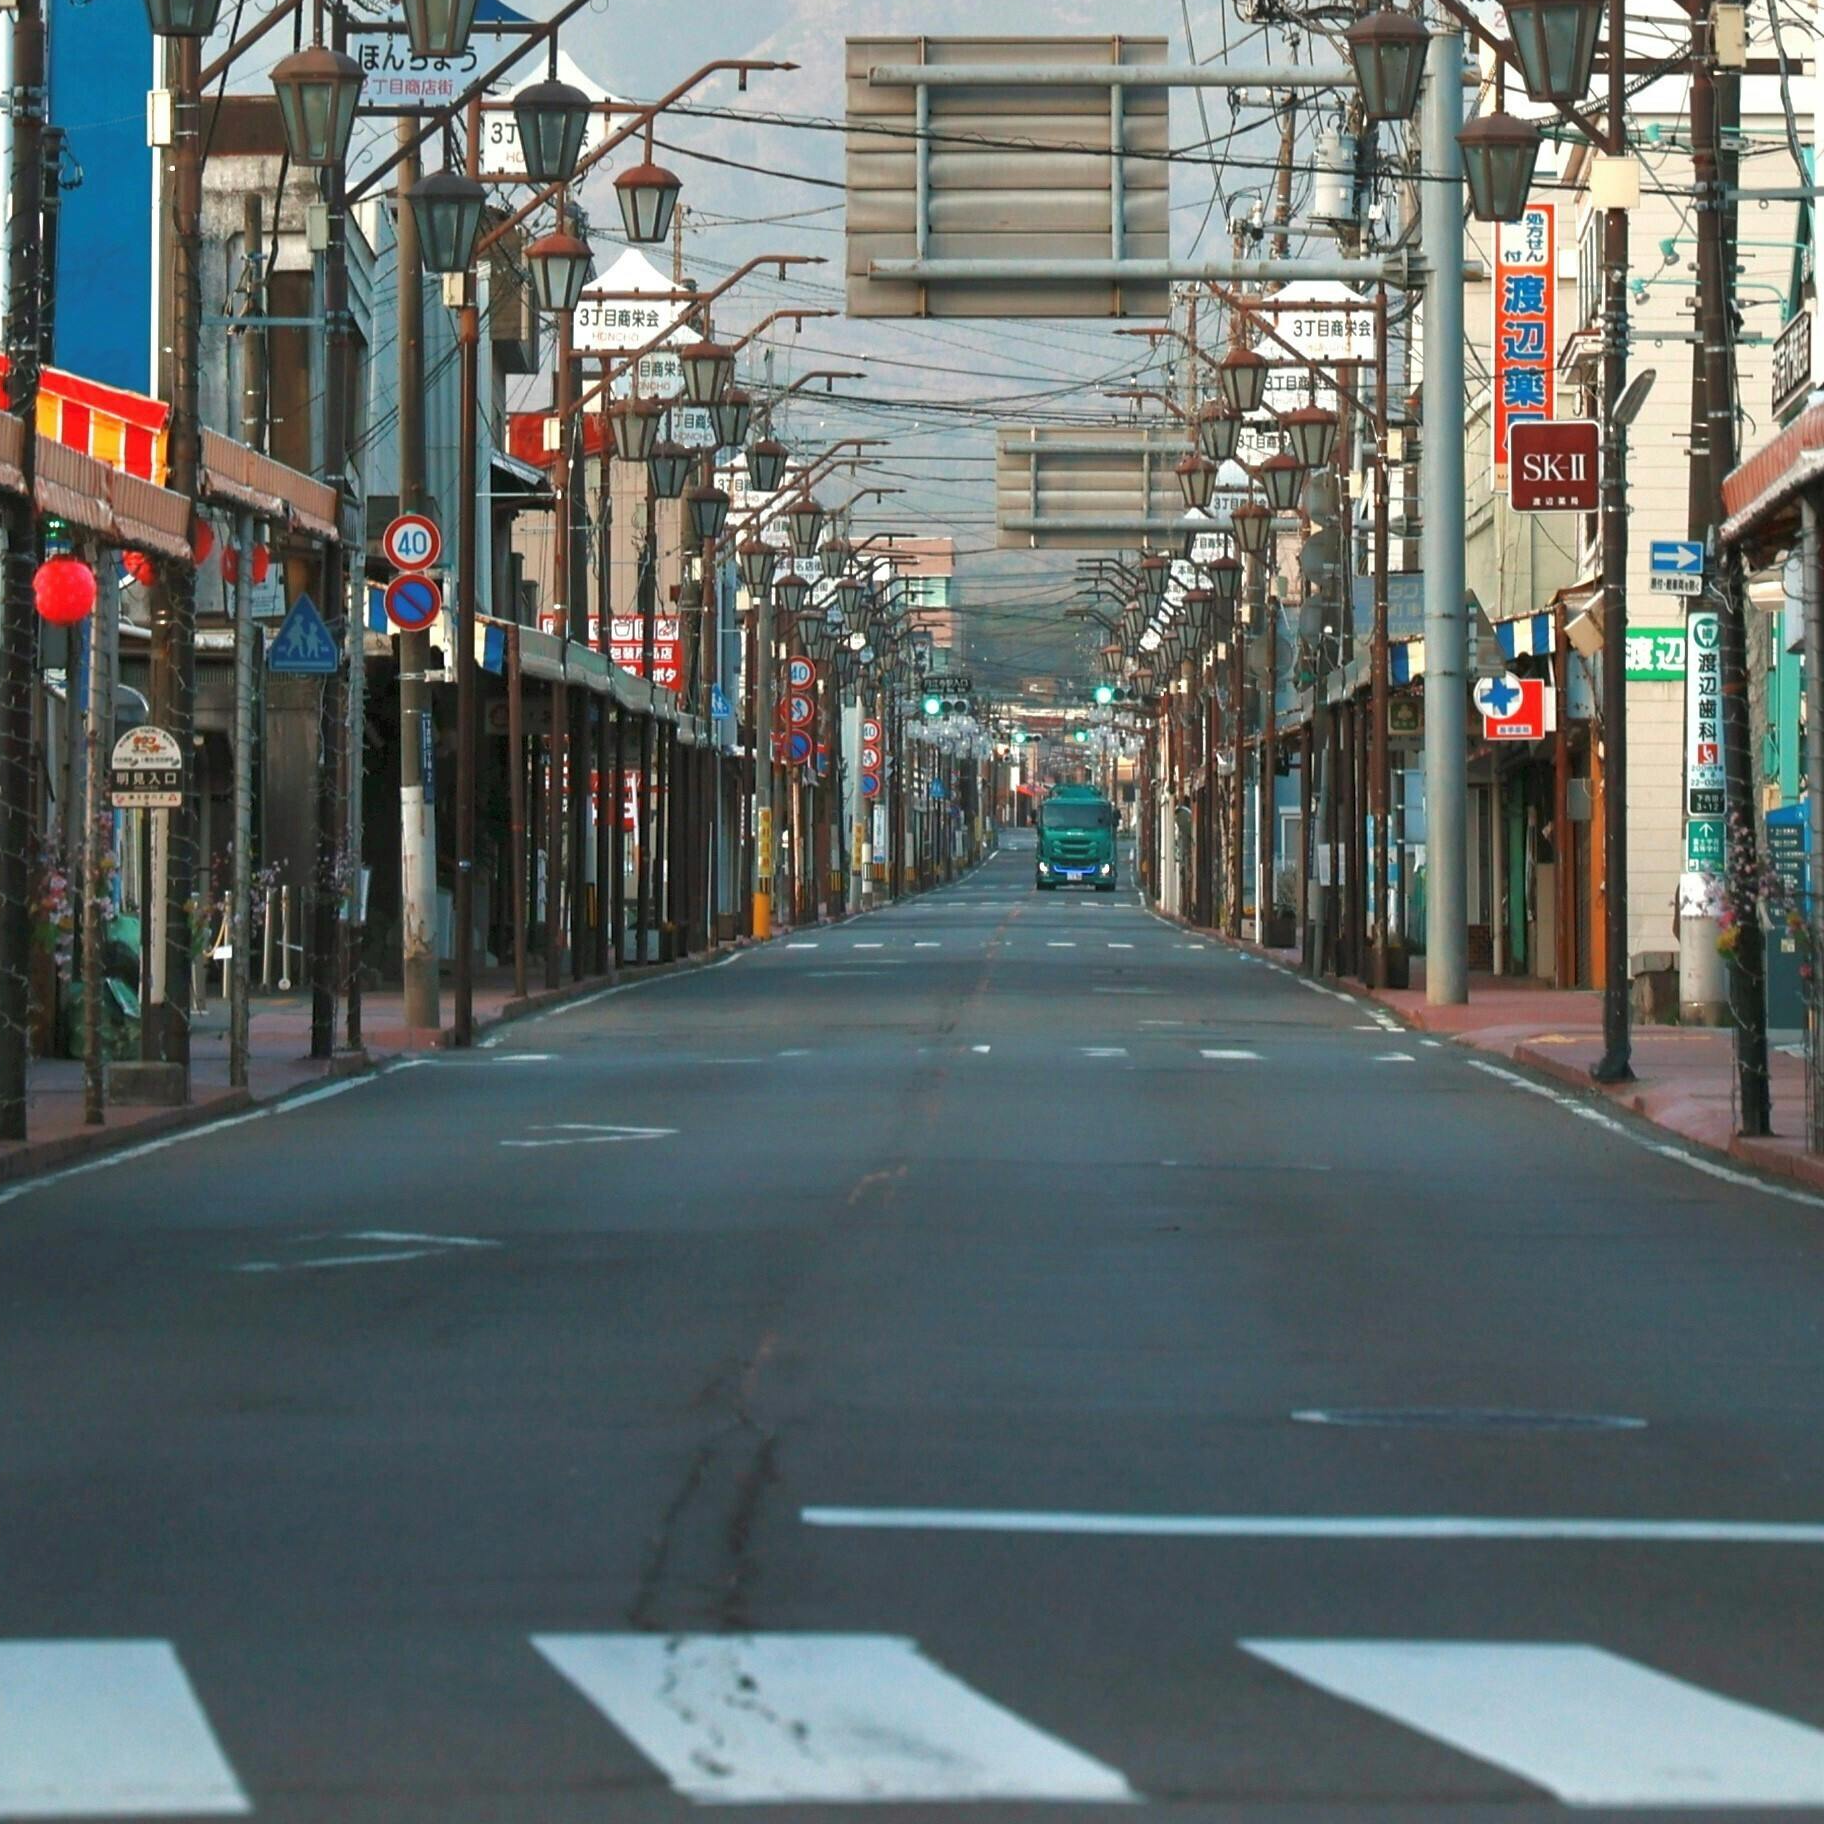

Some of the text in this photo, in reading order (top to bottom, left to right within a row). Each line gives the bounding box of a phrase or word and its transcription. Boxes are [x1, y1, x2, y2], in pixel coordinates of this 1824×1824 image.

[1525, 212, 1545, 263] 処方せん
[580, 308, 659, 329] 3丁目商栄会
[1293, 319, 1371, 337] 3丁目商栄会
[398, 531, 427, 555] 40
[1697, 652, 1717, 742] 渡辺歯科
[116, 770, 177, 785] 明見入口
